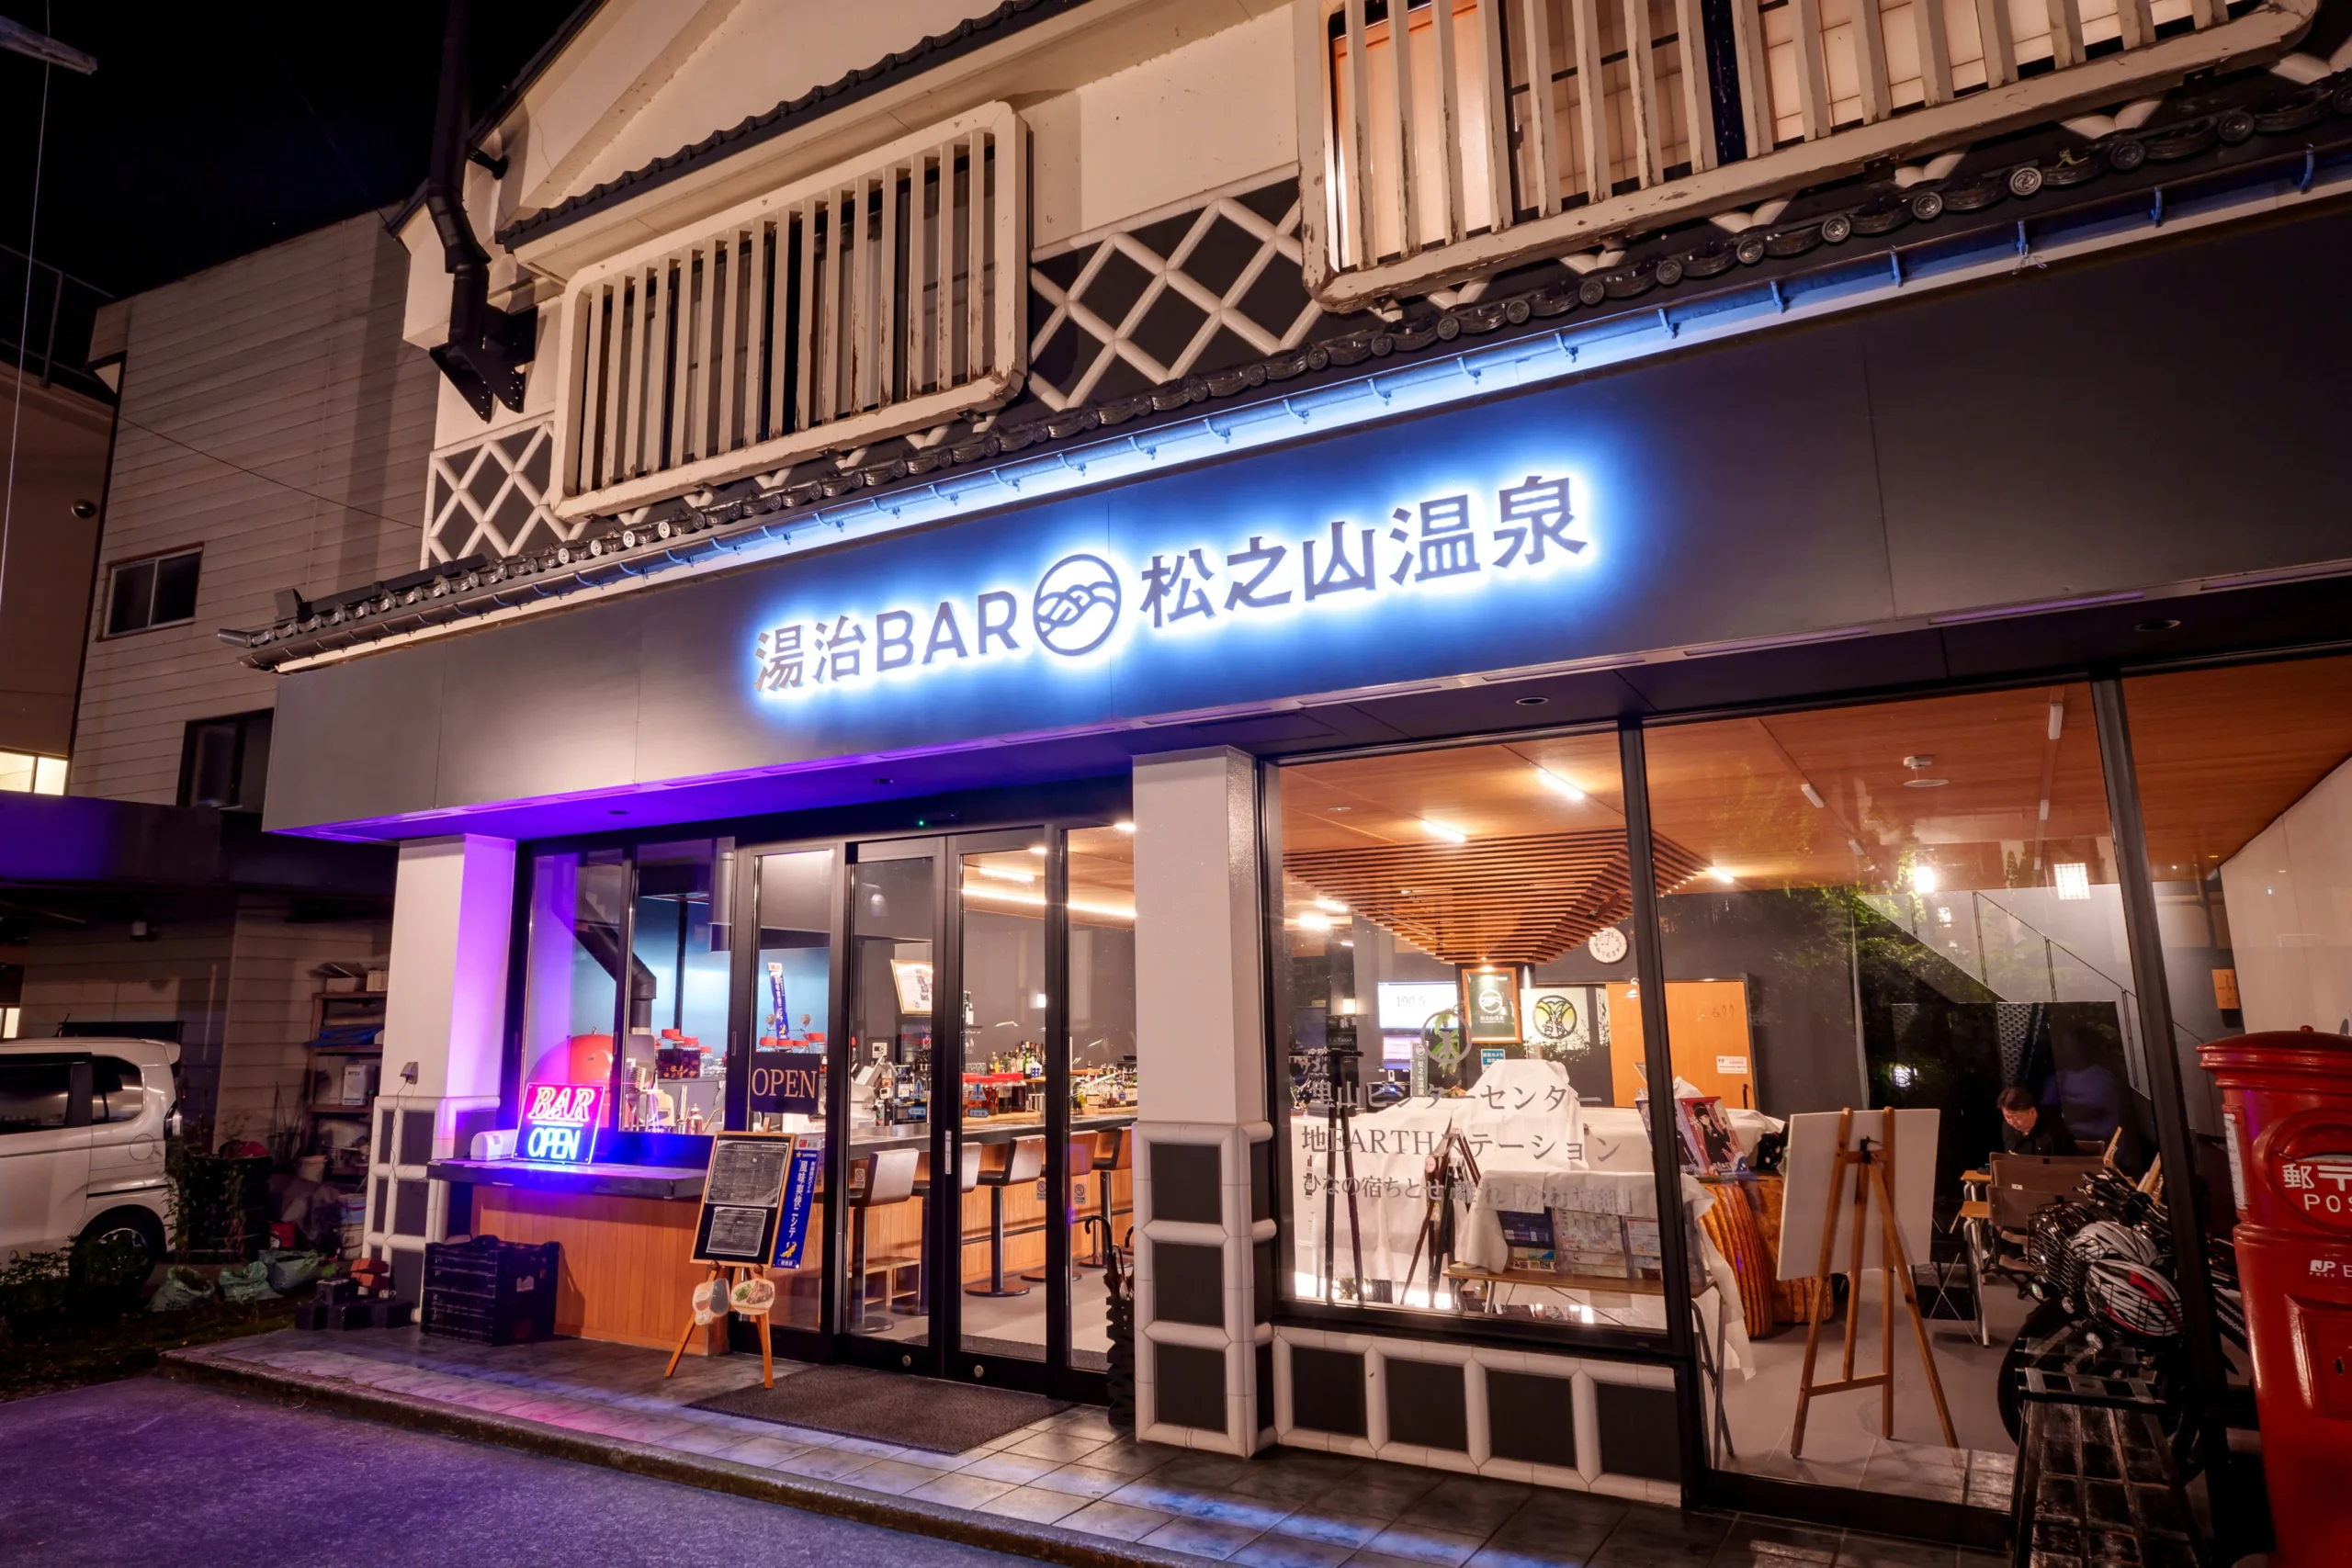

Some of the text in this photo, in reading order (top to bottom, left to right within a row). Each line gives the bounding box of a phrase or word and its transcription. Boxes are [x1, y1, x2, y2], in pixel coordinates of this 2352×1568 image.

[753, 475, 1589, 693] 湯治BAR 松之山温泉
[751, 1067, 819, 1100] OPEN
[527, 1087, 595, 1122] BAR
[527, 1126, 582, 1160] OPEN
[2303, 1193, 2352, 1213] PO
